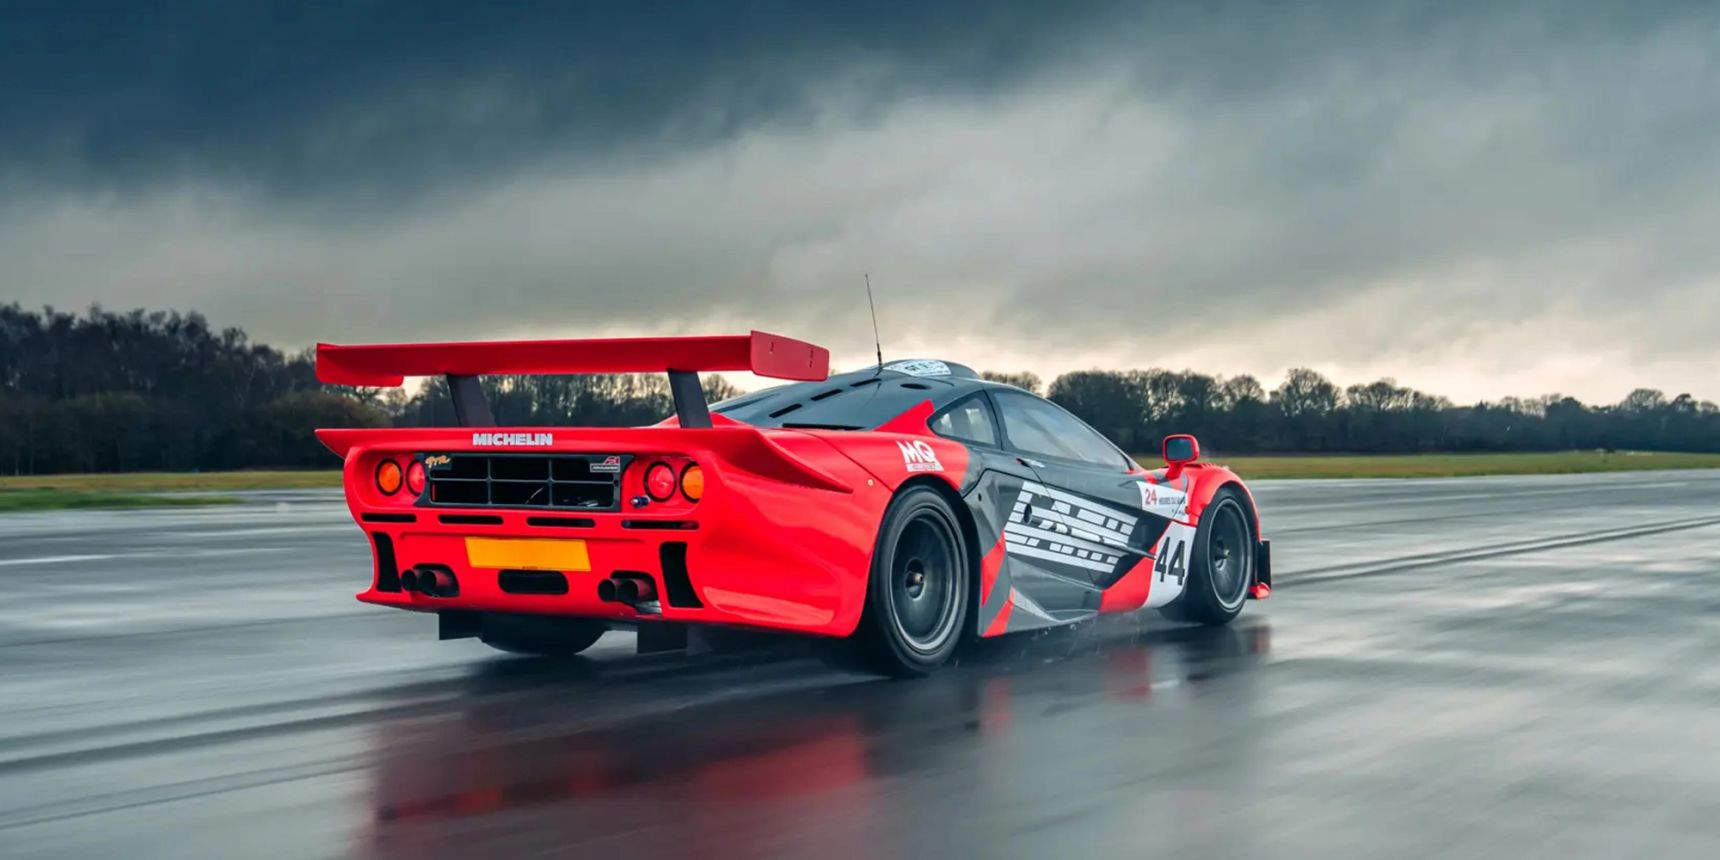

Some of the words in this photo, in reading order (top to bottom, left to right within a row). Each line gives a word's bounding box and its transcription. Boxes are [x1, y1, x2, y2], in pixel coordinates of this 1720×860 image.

[472, 433, 553, 446] MICHELIN
[1145, 488, 1157, 505] 24
[1154, 537, 1185, 586] 44
